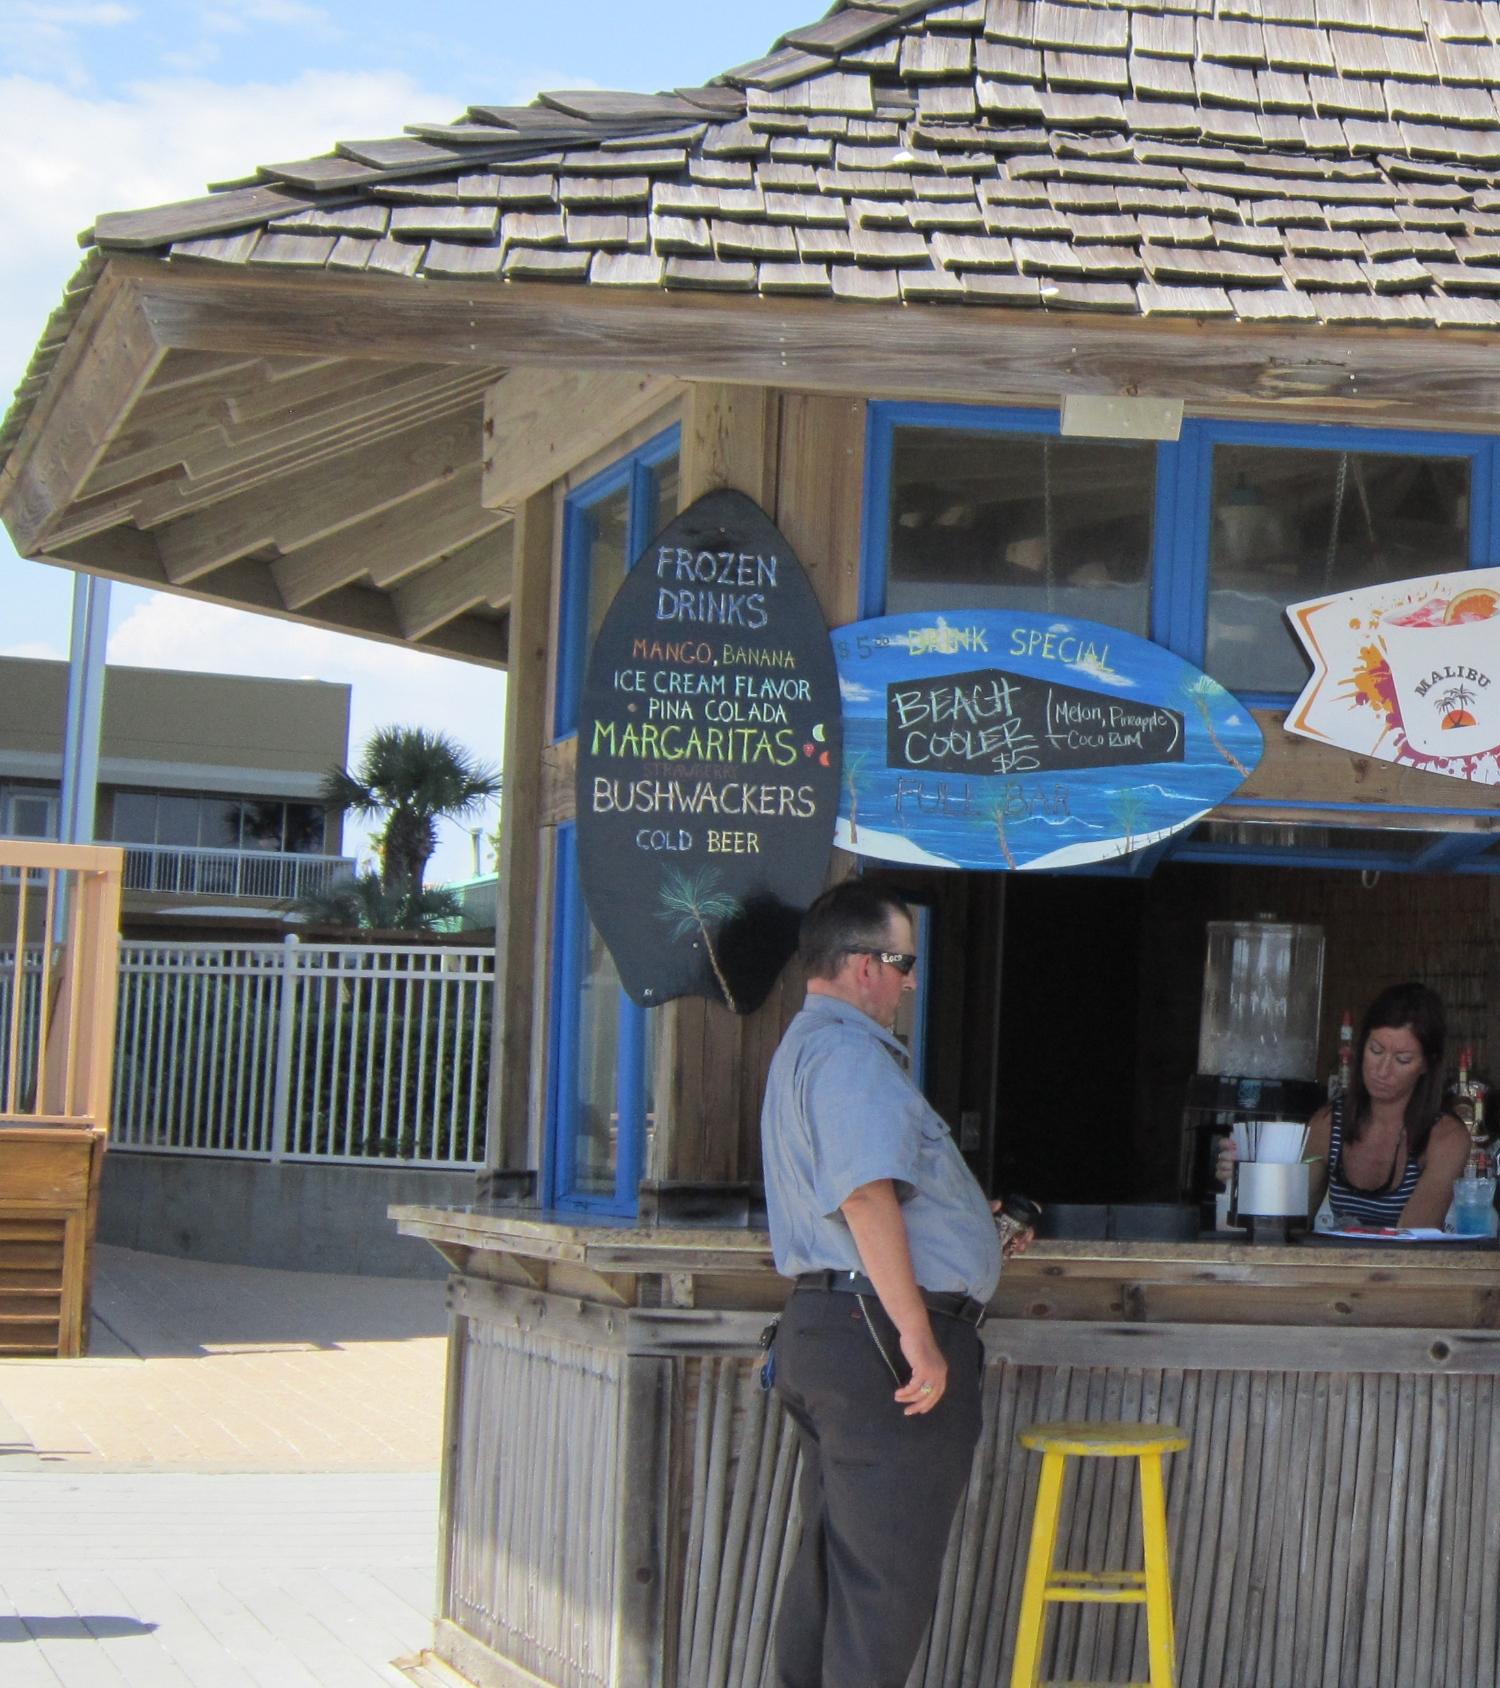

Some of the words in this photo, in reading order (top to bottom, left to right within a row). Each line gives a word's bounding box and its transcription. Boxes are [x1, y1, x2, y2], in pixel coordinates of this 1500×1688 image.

[657, 546, 777, 587] FROZEN
[656, 587, 768, 629] DRINKS
[723, 644, 796, 669] BANANA
[1010, 628, 1115, 673] SPECIAL
[614, 669, 647, 692] ICE
[653, 671, 725, 695] CREAM
[735, 675, 812, 701] FLAVOR
[1414, 665, 1491, 697] MALIBU
[649, 698, 694, 720] PINA
[704, 700, 788, 724] COLADA
[892, 677, 1021, 728] BEACH
[591, 720, 798, 766] MARGARITAS
[905, 717, 1037, 764] COOLER
[592, 776, 816, 818] BUSHWACKERS
[896, 776, 980, 817] FULL
[1004, 783, 1070, 816] BAR
[636, 829, 692, 851] COLD
[707, 830, 759, 853] BEER
